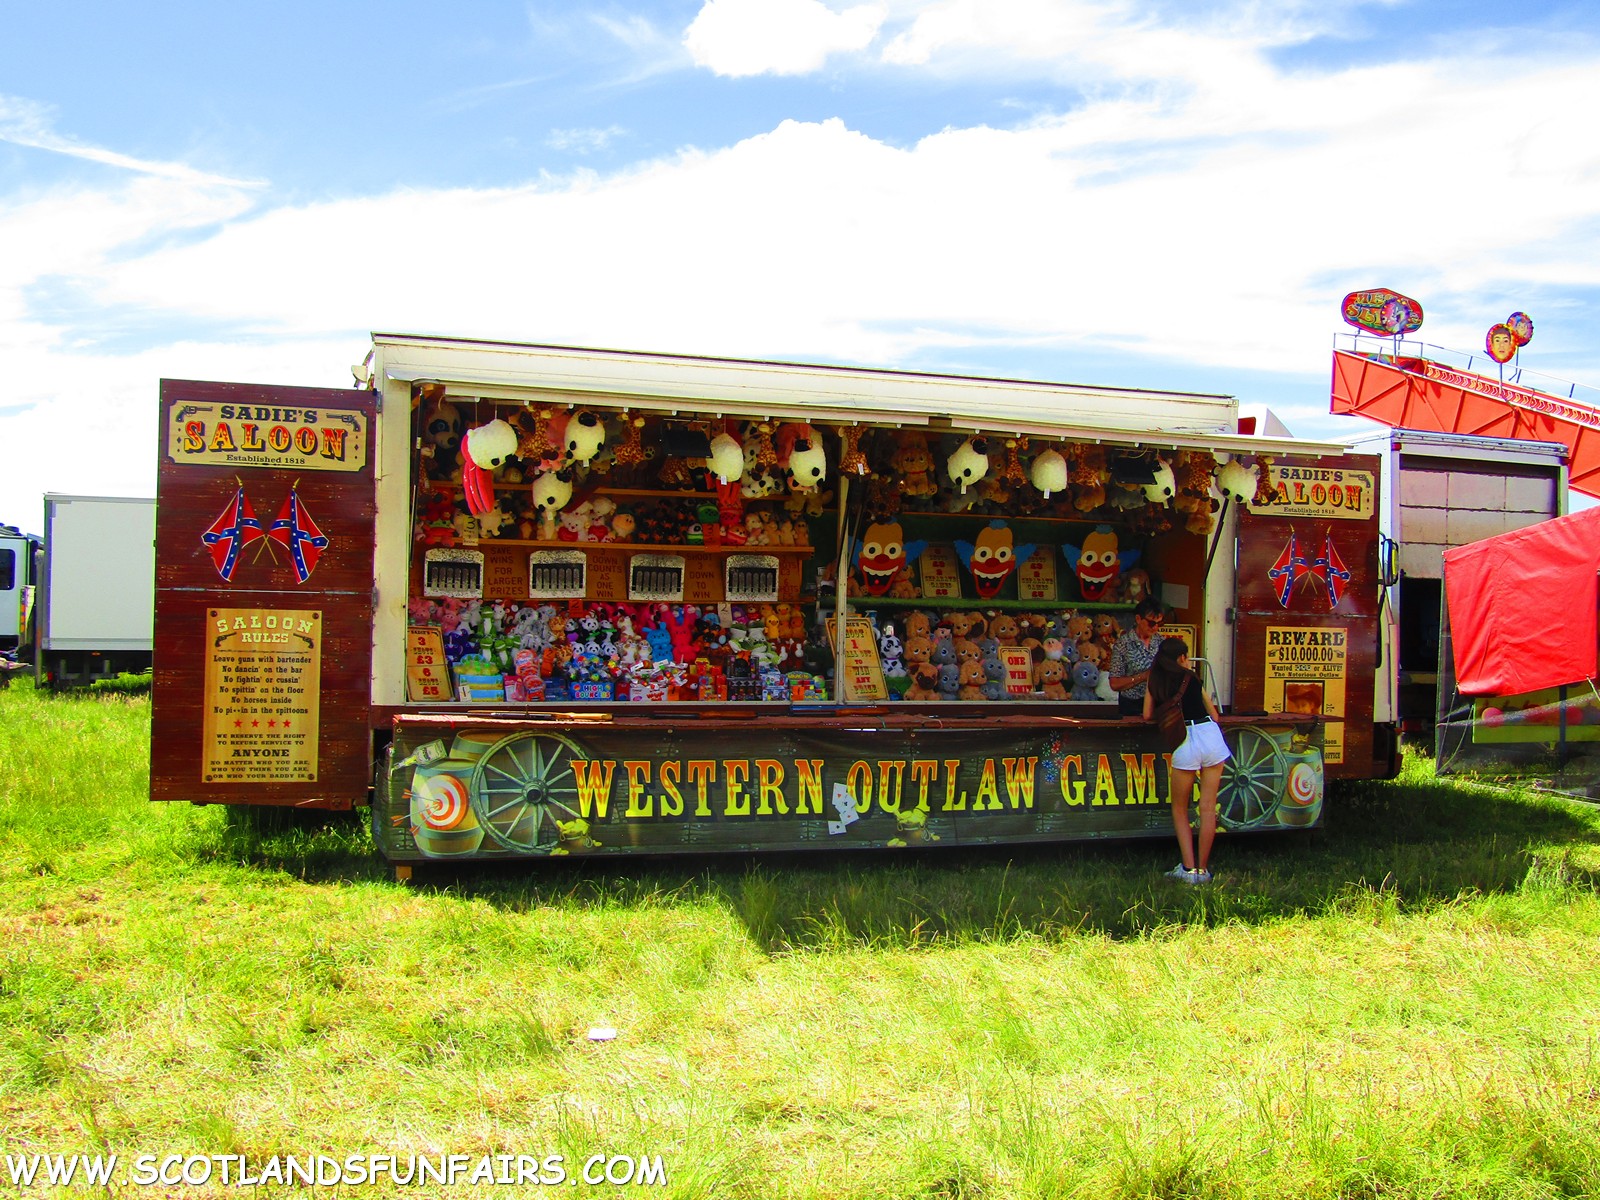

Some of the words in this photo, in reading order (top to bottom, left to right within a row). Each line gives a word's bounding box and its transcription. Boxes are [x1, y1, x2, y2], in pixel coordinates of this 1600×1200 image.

[220, 405, 318, 423] SADIE'S
[184, 420, 348, 462] SALOON
[226, 454, 282, 464] Established
[285, 457, 306, 465] 1818
[1279, 468, 1344, 482] SADIE'S
[1256, 481, 1362, 512] ALOON
[1283, 506, 1320, 514] Established
[490, 546, 512, 554] SAVE
[490, 555, 514, 564] WINS
[592, 556, 618, 565] DOWN
[494, 567, 513, 575] FOR
[588, 563, 622, 573] COUNTS
[689, 571, 714, 579] DOWN
[488, 577, 523, 585] LARGER
[490, 586, 524, 595] PRIZES
[596, 590, 613, 598] WIN
[721, 604, 728, 612] 2
[216, 615, 314, 634] SALOON
[241, 632, 289, 643] RULES
[417, 636, 426, 646] 3
[1268, 631, 1345, 646] REWARD
[850, 639, 859, 649] 1
[1279, 646, 1333, 661] $10,000.00
[238, 656, 255, 664] guns
[258, 655, 274, 663] with
[416, 655, 433, 664] £3
[1007, 656, 1026, 666] ONE
[422, 667, 431, 677] 6
[236, 676, 262, 685] fightin'
[855, 676, 871, 684] ANY
[232, 686, 257, 695] spittin'
[423, 686, 439, 695] £5
[582, 684, 604, 692] HIGH
[276, 707, 308, 715] spittoons
[231, 749, 290, 757] ANYONE
[570, 758, 825, 818] WESTERN
[846, 756, 1039, 814] OUTLAW
